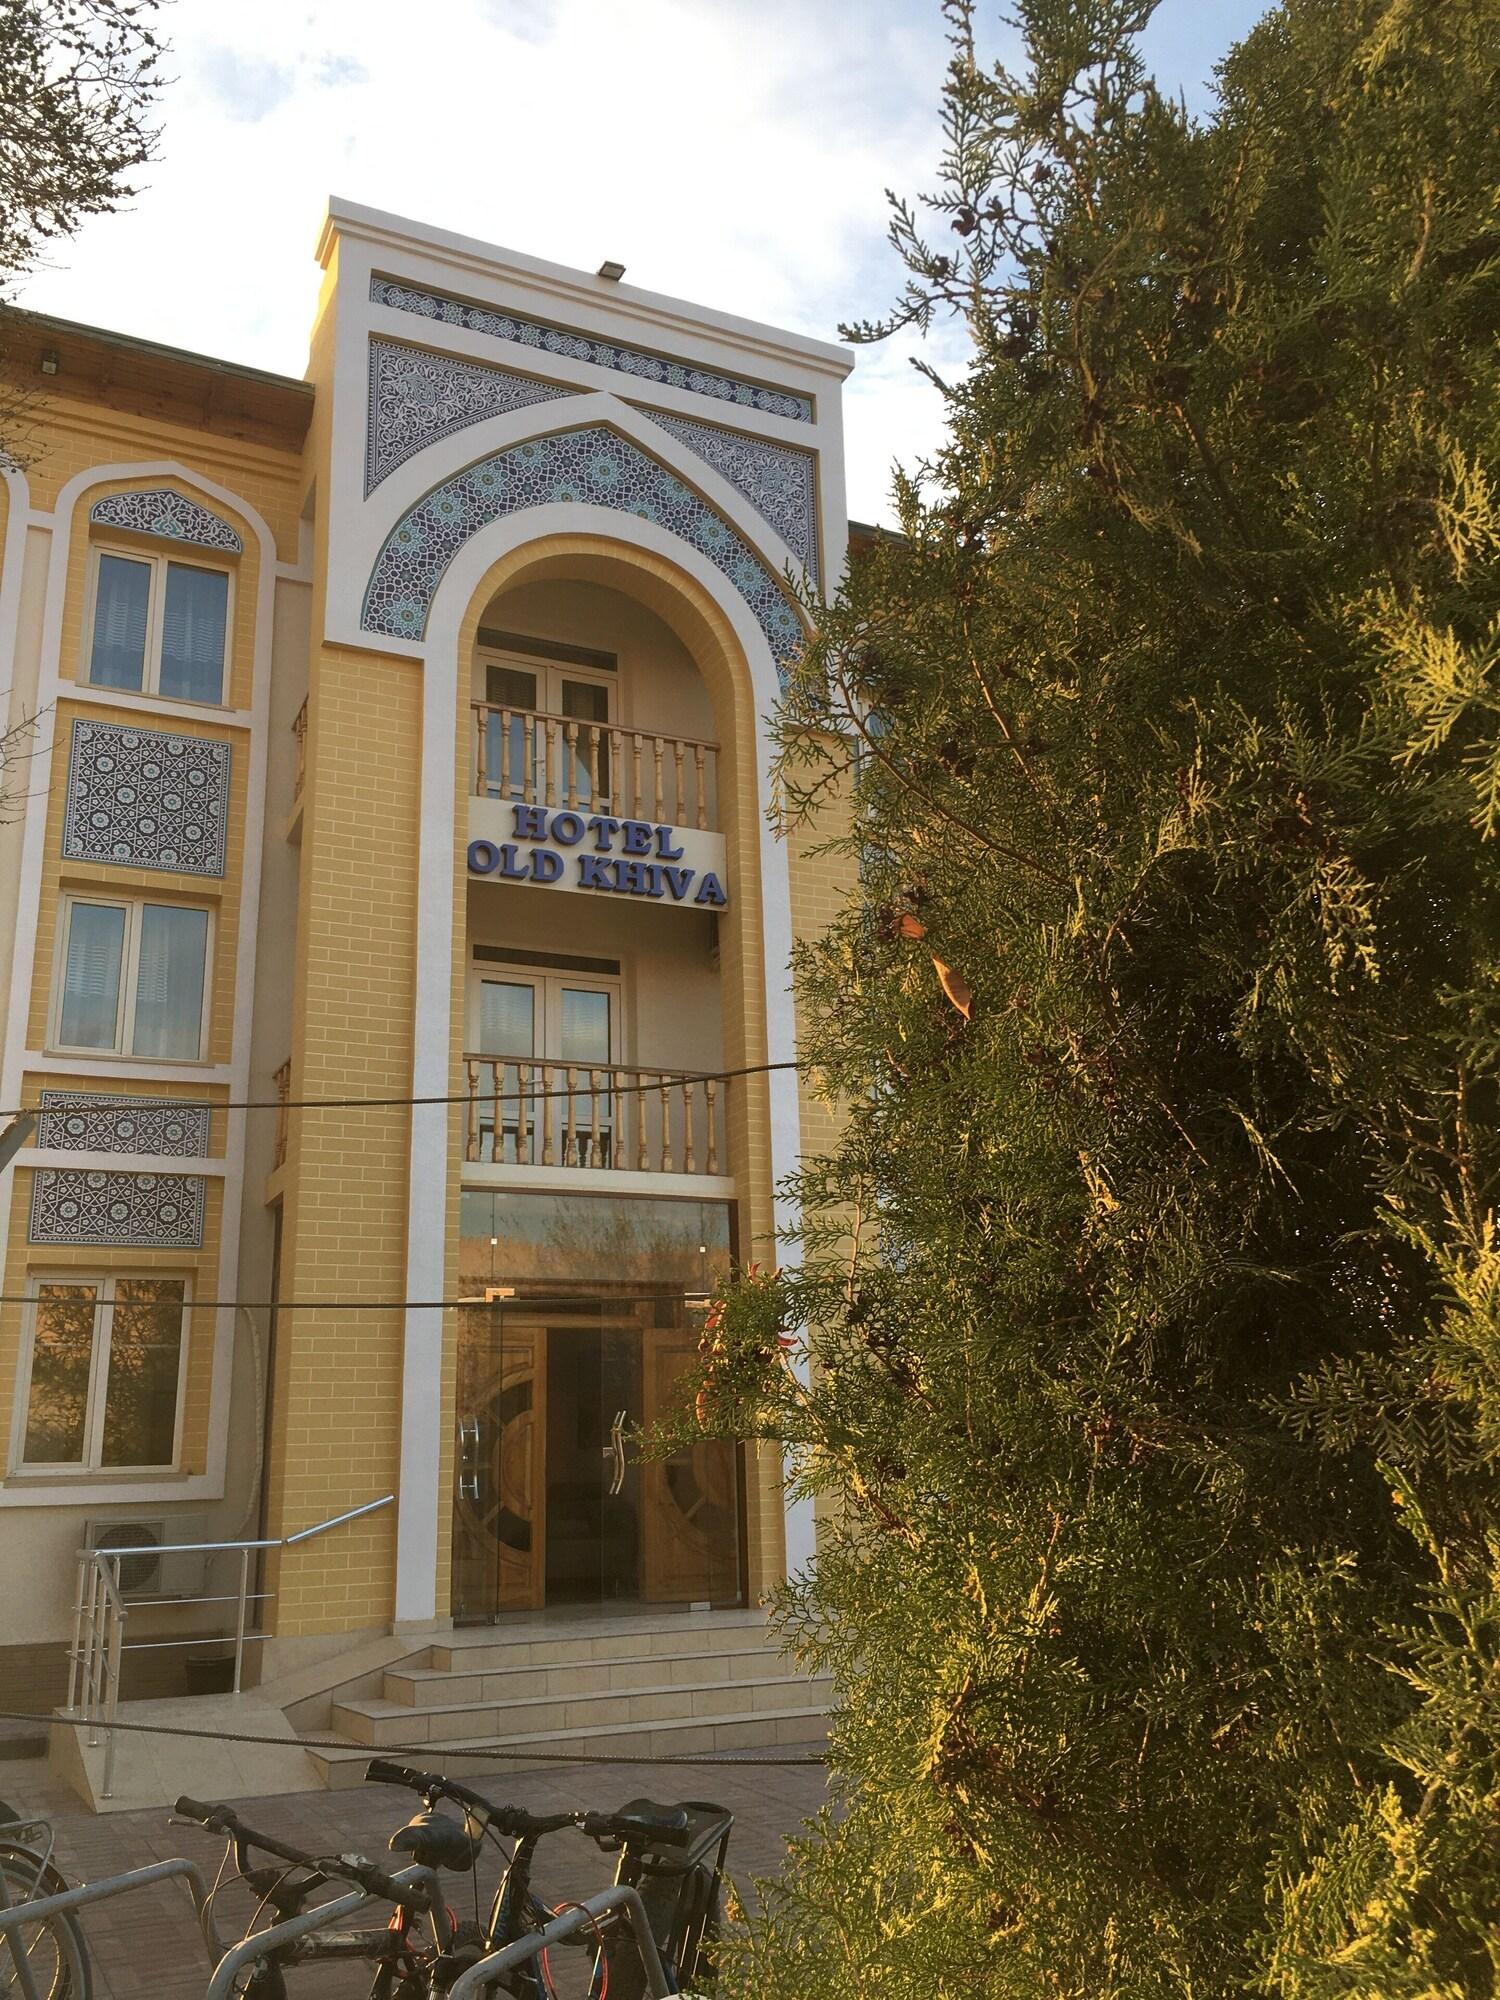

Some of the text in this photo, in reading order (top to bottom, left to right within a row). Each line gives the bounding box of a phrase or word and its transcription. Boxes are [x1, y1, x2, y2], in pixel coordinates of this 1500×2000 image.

[512, 805, 684, 860] HOTEL
[467, 840, 727, 905] OLD KHIVA
